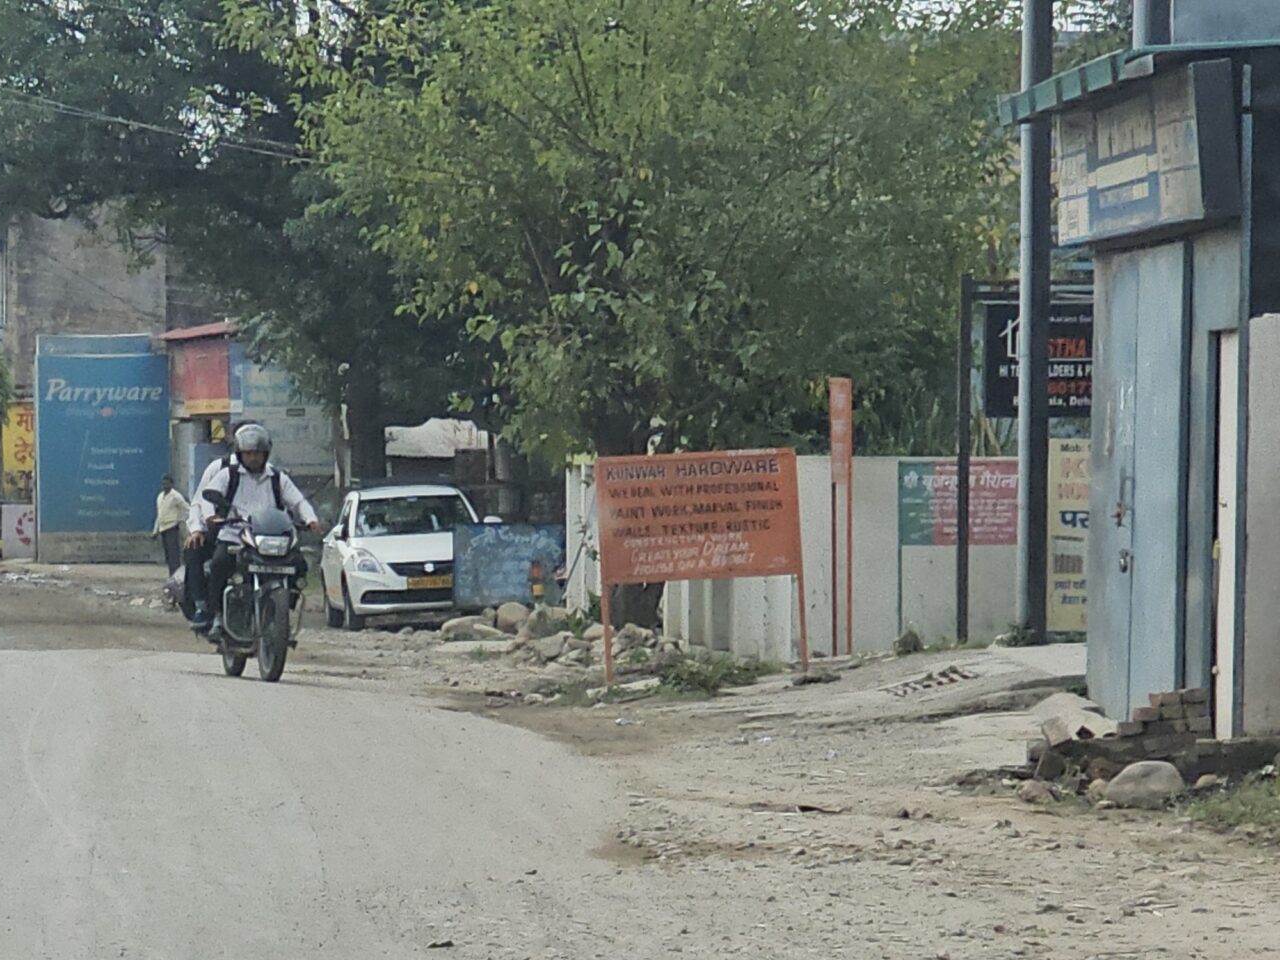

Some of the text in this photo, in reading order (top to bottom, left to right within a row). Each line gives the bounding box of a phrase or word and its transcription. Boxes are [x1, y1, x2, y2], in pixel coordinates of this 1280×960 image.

[1048, 338, 1087, 357] STHA
[45, 378, 162, 406] Parryware
[607, 459, 780, 481] KUNWAR HARDWARE
[660, 484, 694, 497] WITH
